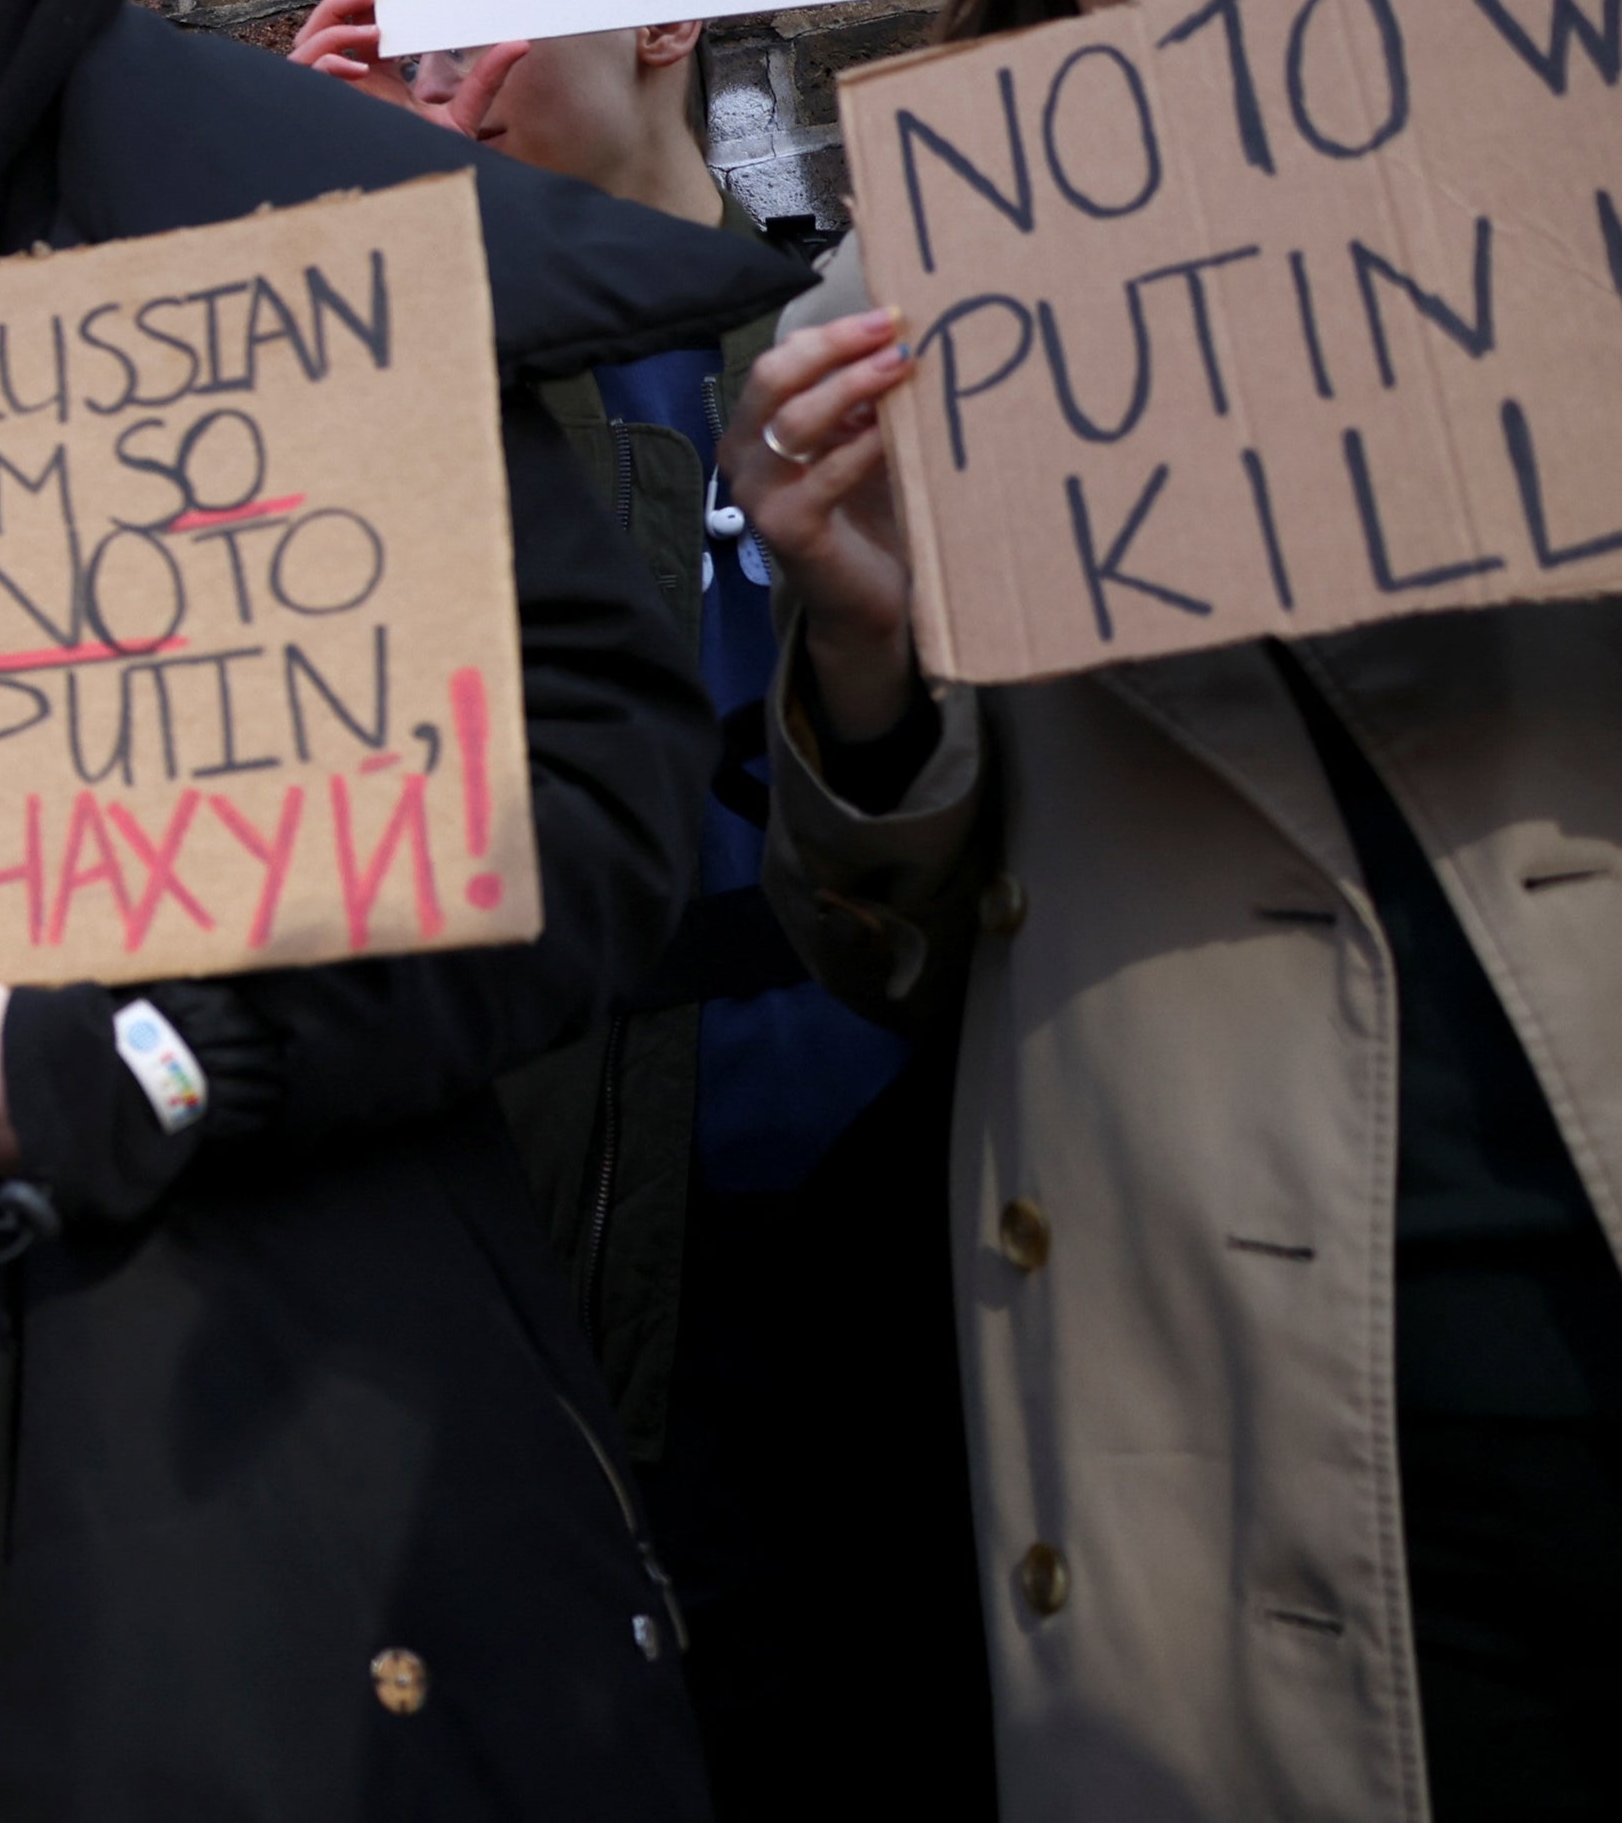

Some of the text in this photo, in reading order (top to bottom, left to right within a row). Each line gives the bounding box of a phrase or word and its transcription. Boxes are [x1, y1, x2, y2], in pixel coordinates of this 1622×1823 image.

[895, 44, 1163, 274] NO
[917, 216, 1497, 472] PUTIN
[110, 408, 267, 534] SO
[191, 507, 386, 625] TO
